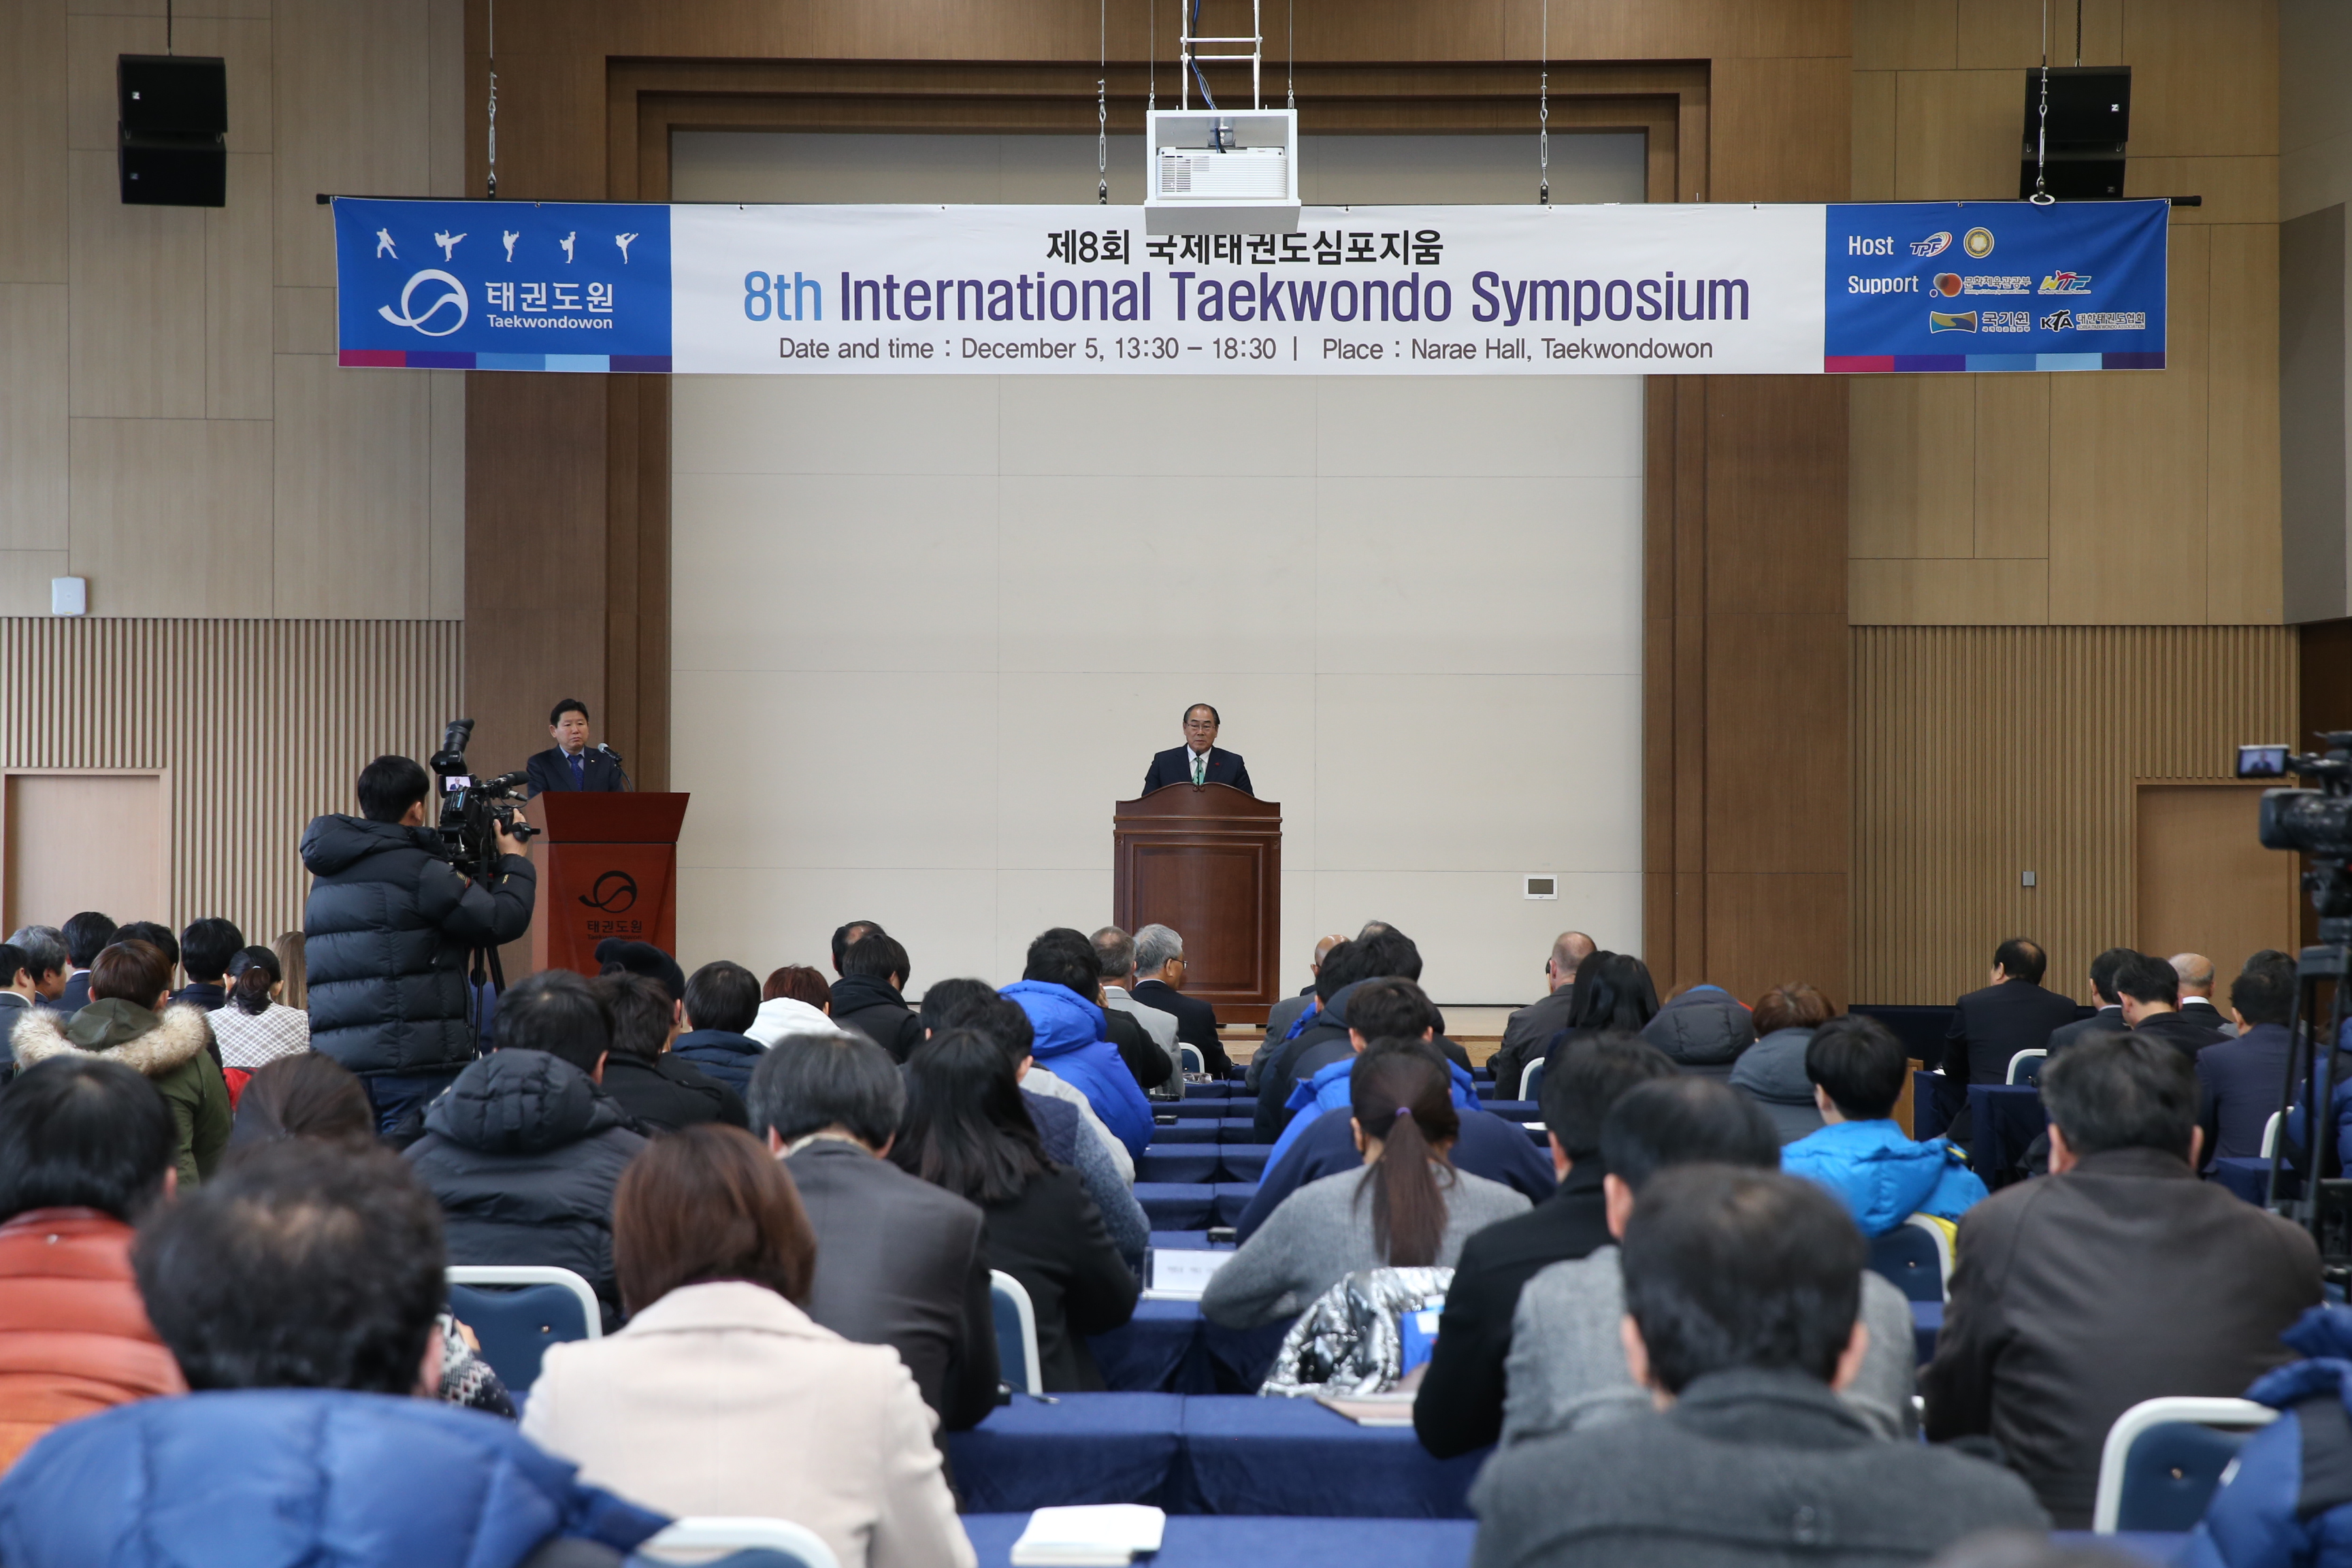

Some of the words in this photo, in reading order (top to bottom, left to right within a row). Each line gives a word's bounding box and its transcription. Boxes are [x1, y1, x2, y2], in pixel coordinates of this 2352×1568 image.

[1046, 229, 1130, 265] 제8회
[1145, 229, 1444, 265] 국제태권도심포지움
[1848, 235, 1894, 256] Host
[1910, 242, 1943, 256] TPF
[1848, 275, 1919, 295] Support
[1963, 276, 2031, 289] 문화체육관광부
[485, 282, 613, 313] 태권도원
[744, 270, 821, 322] 8th
[841, 272, 1151, 322] International
[1169, 272, 1452, 323] Taekwondo
[1472, 270, 1749, 327] Symposium
[487, 314, 612, 329] Taekwondowon
[1982, 312, 2029, 325] 국기원
[2041, 310, 2074, 331] KTA
[2077, 312, 2145, 324] 대한태권도협회
[780, 337, 830, 359] Date
[838, 337, 879, 359] and
[887, 337, 934, 359] time
[962, 338, 1077, 359] December
[1085, 338, 1104, 362] 5,
[1115, 337, 1179, 359] 13:30
[1213, 337, 1277, 360] 18:30
[1323, 338, 1384, 360] Place
[1412, 338, 1477, 360] Narae
[1486, 338, 1532, 363] Hall,
[1541, 337, 1713, 359] Taekwondowon
[586, 919, 642, 934] 태권도원
